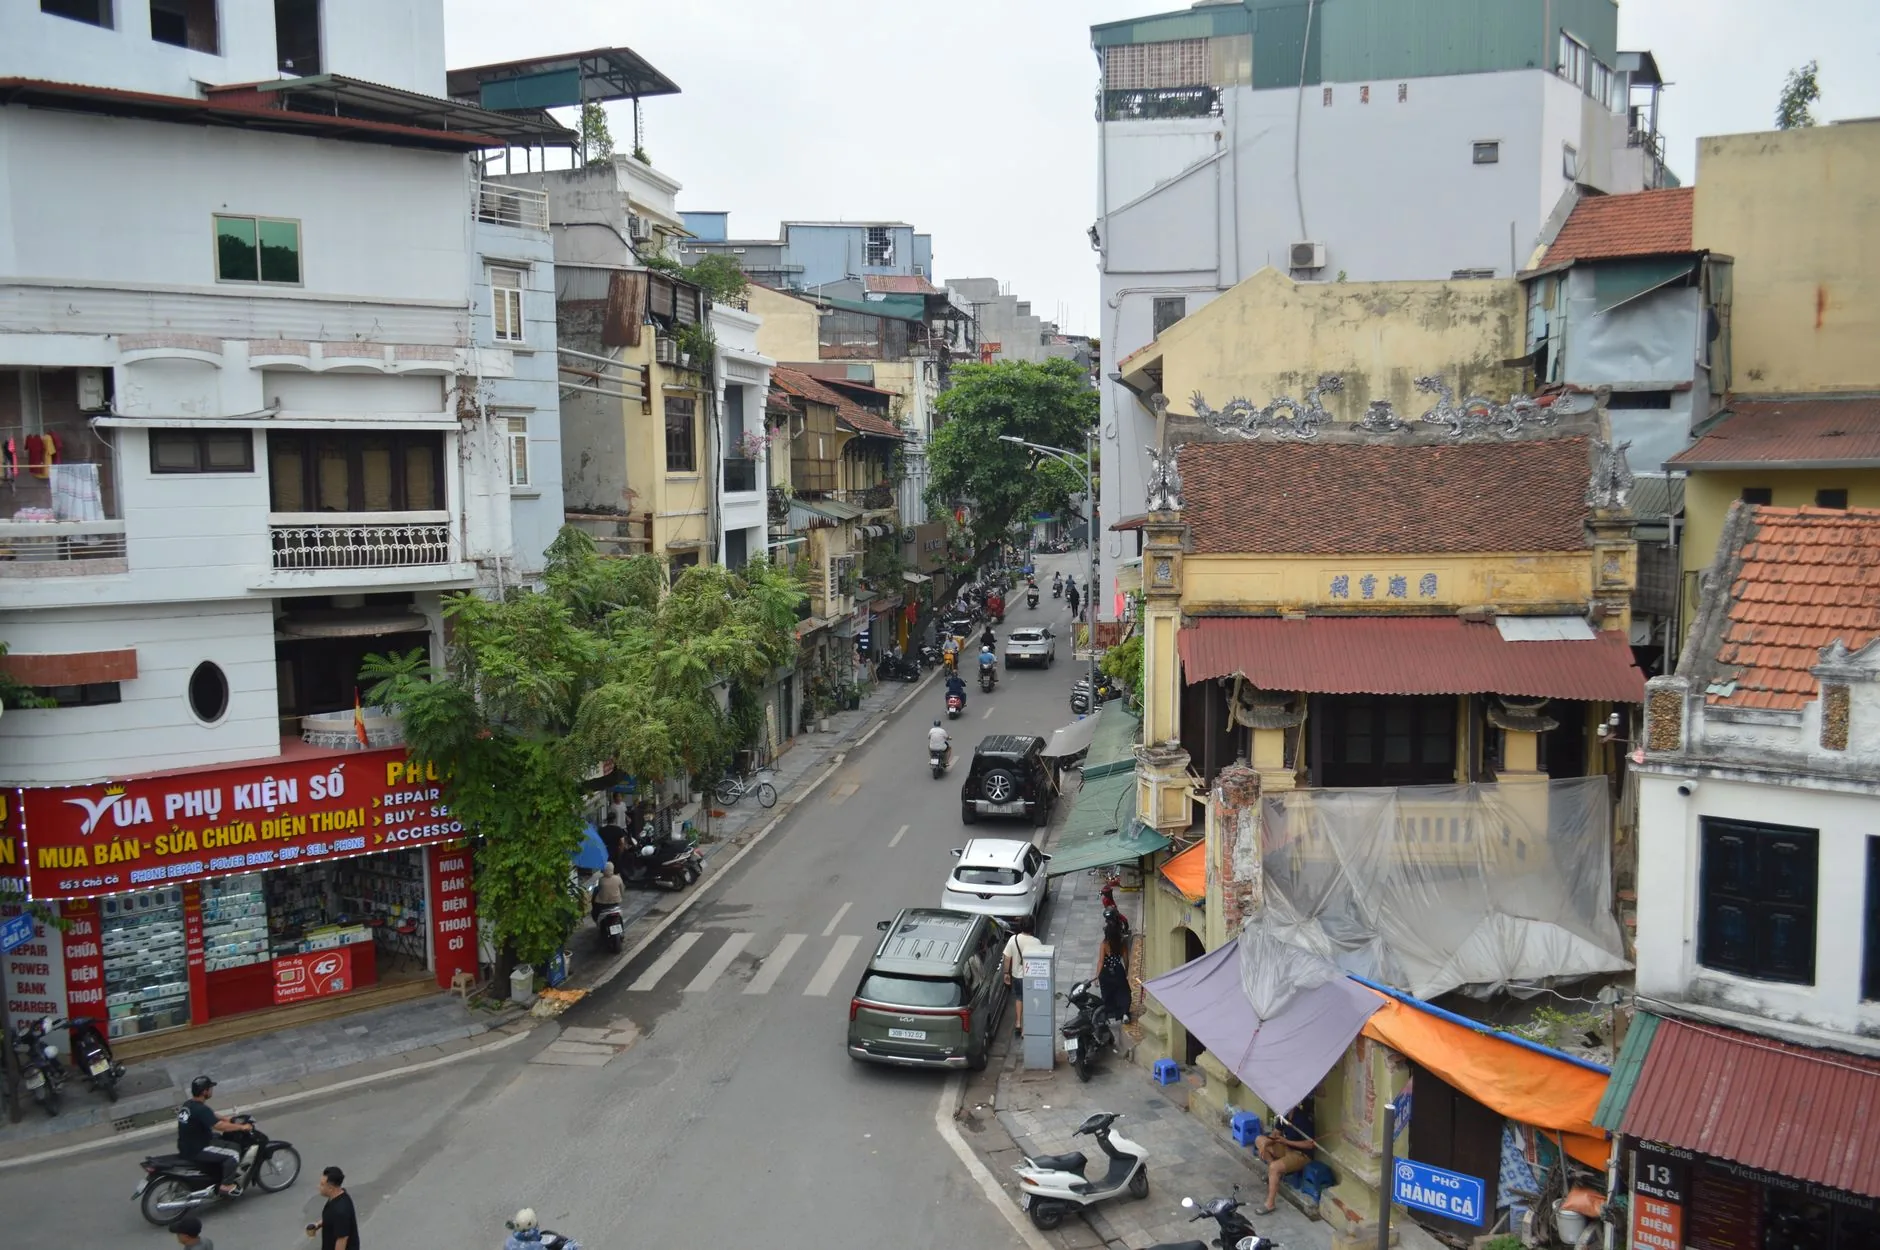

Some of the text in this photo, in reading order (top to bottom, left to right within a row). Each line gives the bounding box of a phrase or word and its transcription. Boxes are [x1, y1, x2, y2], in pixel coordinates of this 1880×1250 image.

[165, 788, 222, 821] PHỤ
[234, 776, 298, 813] KIỆN
[309, 763, 346, 801] SỐ
[384, 788, 440, 806] REPAIR
[385, 809, 416, 825] BUY
[38, 846, 89, 868] MUA
[94, 836, 140, 865] BÁN
[155, 824, 198, 855] SỬA
[202, 819, 257, 849] CHỮA
[261, 812, 306, 841] ĐIỆN
[309, 807, 365, 833] THOẠI
[385, 821, 463, 843] ACCESSO
[130, 867, 167, 883] PHONE
[167, 861, 203, 877] REPAIR
[210, 855, 245, 871] POWER
[247, 850, 274, 866] BANK
[279, 846, 300, 861] BUY
[307, 842, 329, 856] SELL
[334, 837, 365, 852] PHONE
[440, 859, 464, 872] MUA
[441, 877, 464, 892] BÁN
[442, 896, 468, 912] ĐIỆN
[439, 917, 471, 932] THOẠI
[11, 963, 49, 976] POWER
[315, 959, 336, 975] 4G
[17, 982, 46, 995] BANK
[69, 988, 103, 1004] THOẠI
[277, 985, 306, 996] Viettel
[9, 1000, 57, 1013] CHARGER
[1640, 1140, 1693, 1160] Since 2006
[1432, 1174, 1460, 1189] PHỐ
[1647, 1164, 1670, 1185] 13
[1637, 1181, 1664, 1197] Hàng
[1729, 1164, 1873, 1210] Vietnamese Traditional
[1401, 1182, 1447, 1209] HÀNG
